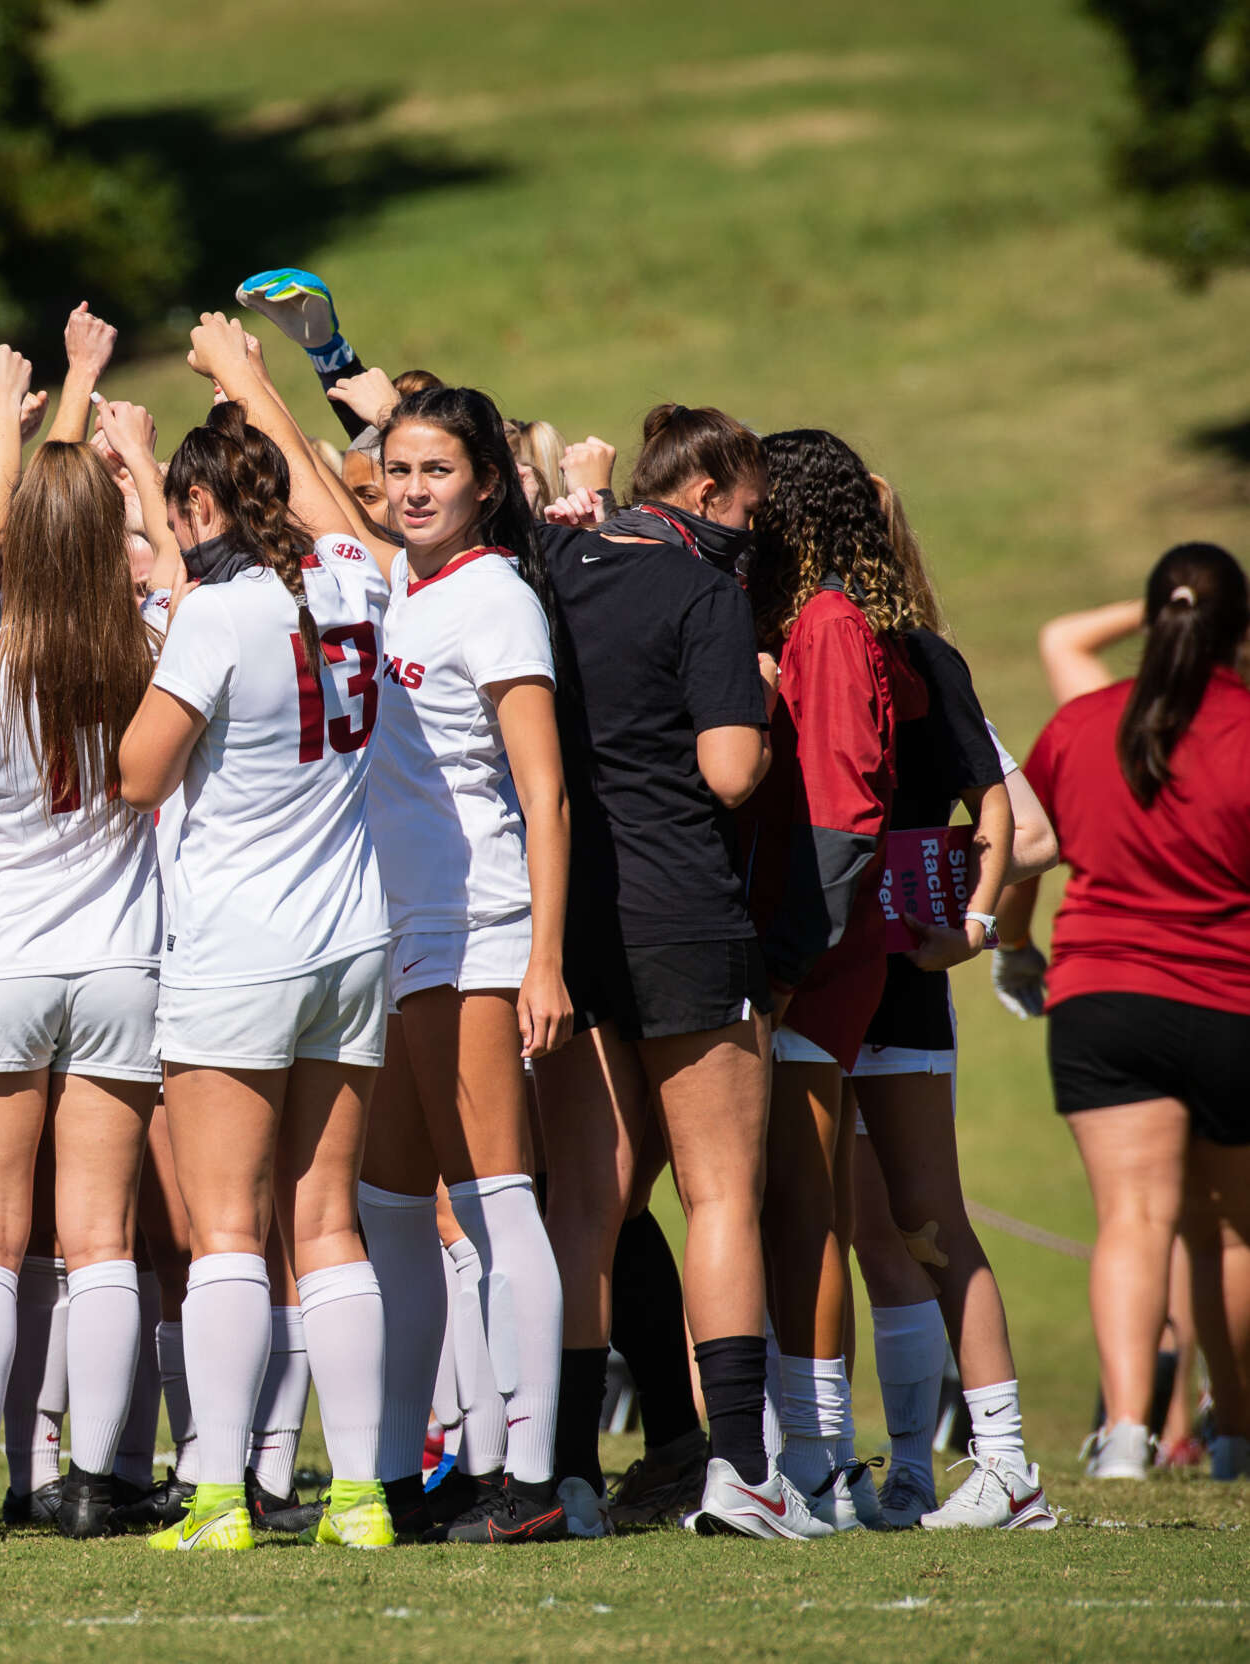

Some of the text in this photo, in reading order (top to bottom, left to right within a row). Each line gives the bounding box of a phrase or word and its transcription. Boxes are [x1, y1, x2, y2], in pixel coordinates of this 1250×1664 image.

[335, 543, 364, 560] SEC
[290, 620, 379, 764] 13
[901, 870, 919, 914] the
